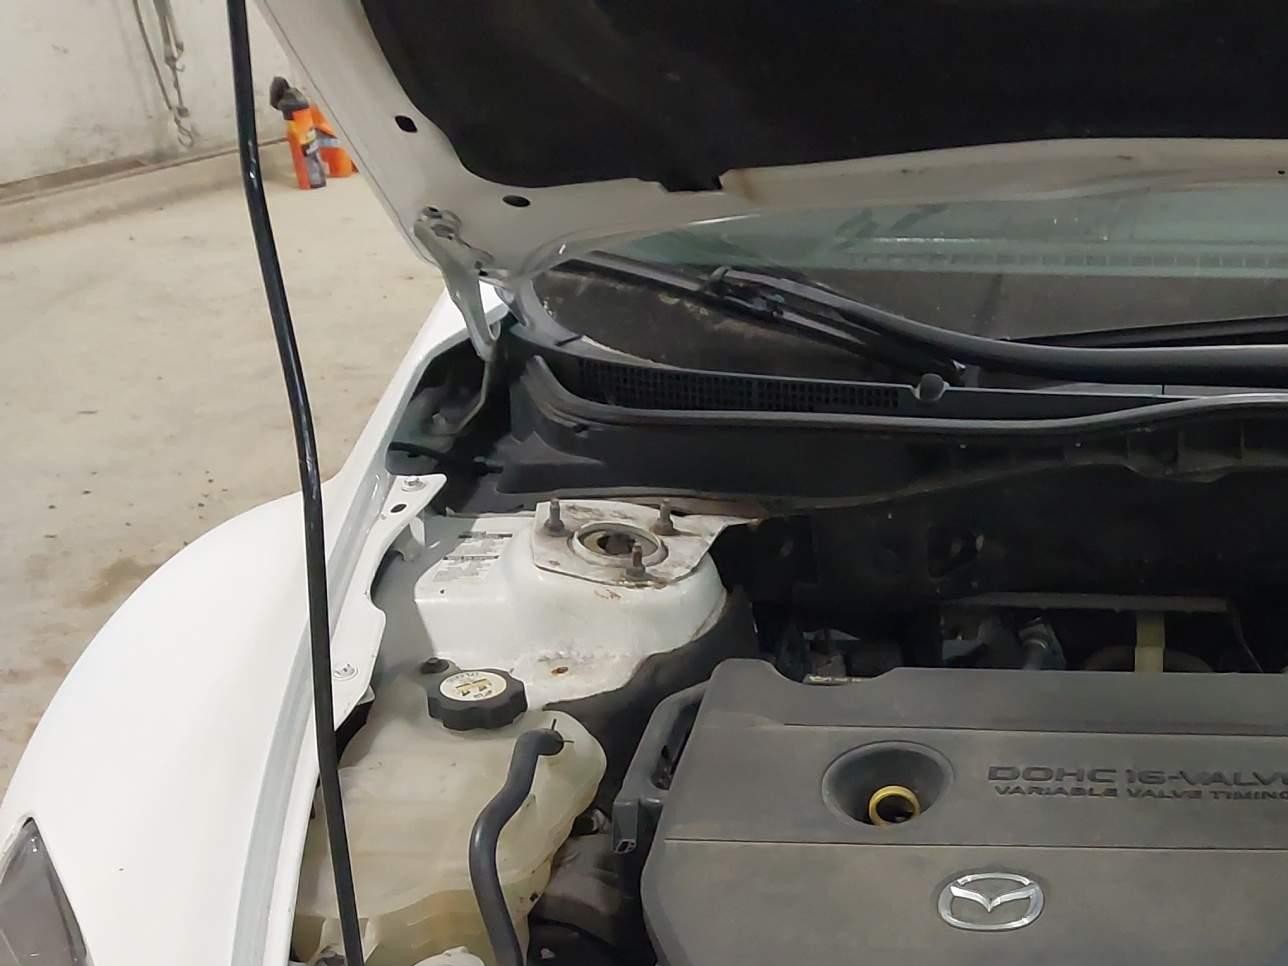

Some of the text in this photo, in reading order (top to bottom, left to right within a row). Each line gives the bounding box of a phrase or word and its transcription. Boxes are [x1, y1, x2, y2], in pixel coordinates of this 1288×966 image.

[988, 765, 1117, 783] DOHC
[994, 785, 1118, 797] VARIABLE
[1126, 787, 1202, 800] VALVE
